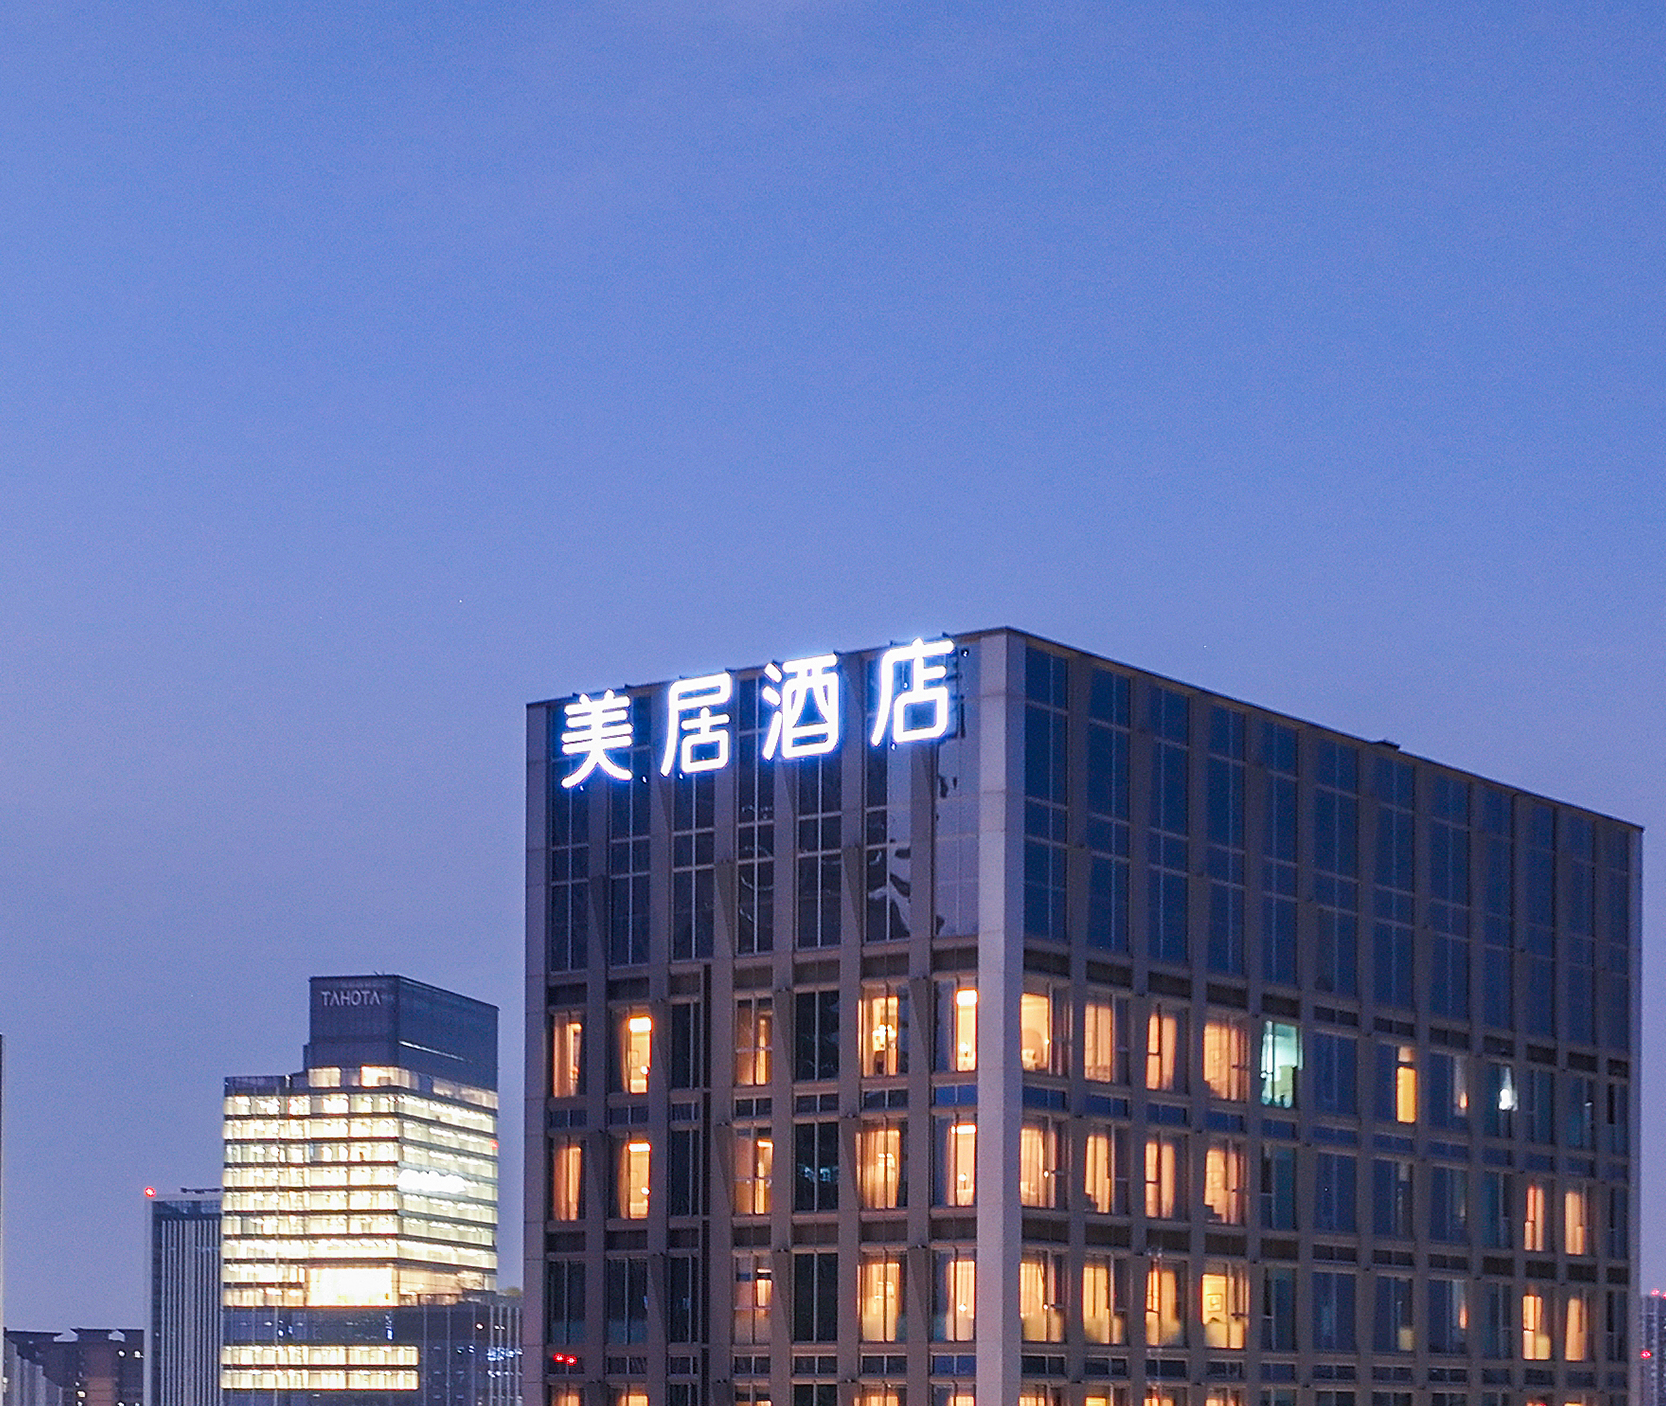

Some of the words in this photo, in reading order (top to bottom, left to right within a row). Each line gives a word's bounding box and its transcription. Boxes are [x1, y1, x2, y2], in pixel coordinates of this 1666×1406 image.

[561, 638, 954, 788] 美居酒店
[321, 990, 381, 1006] TAHOTA
